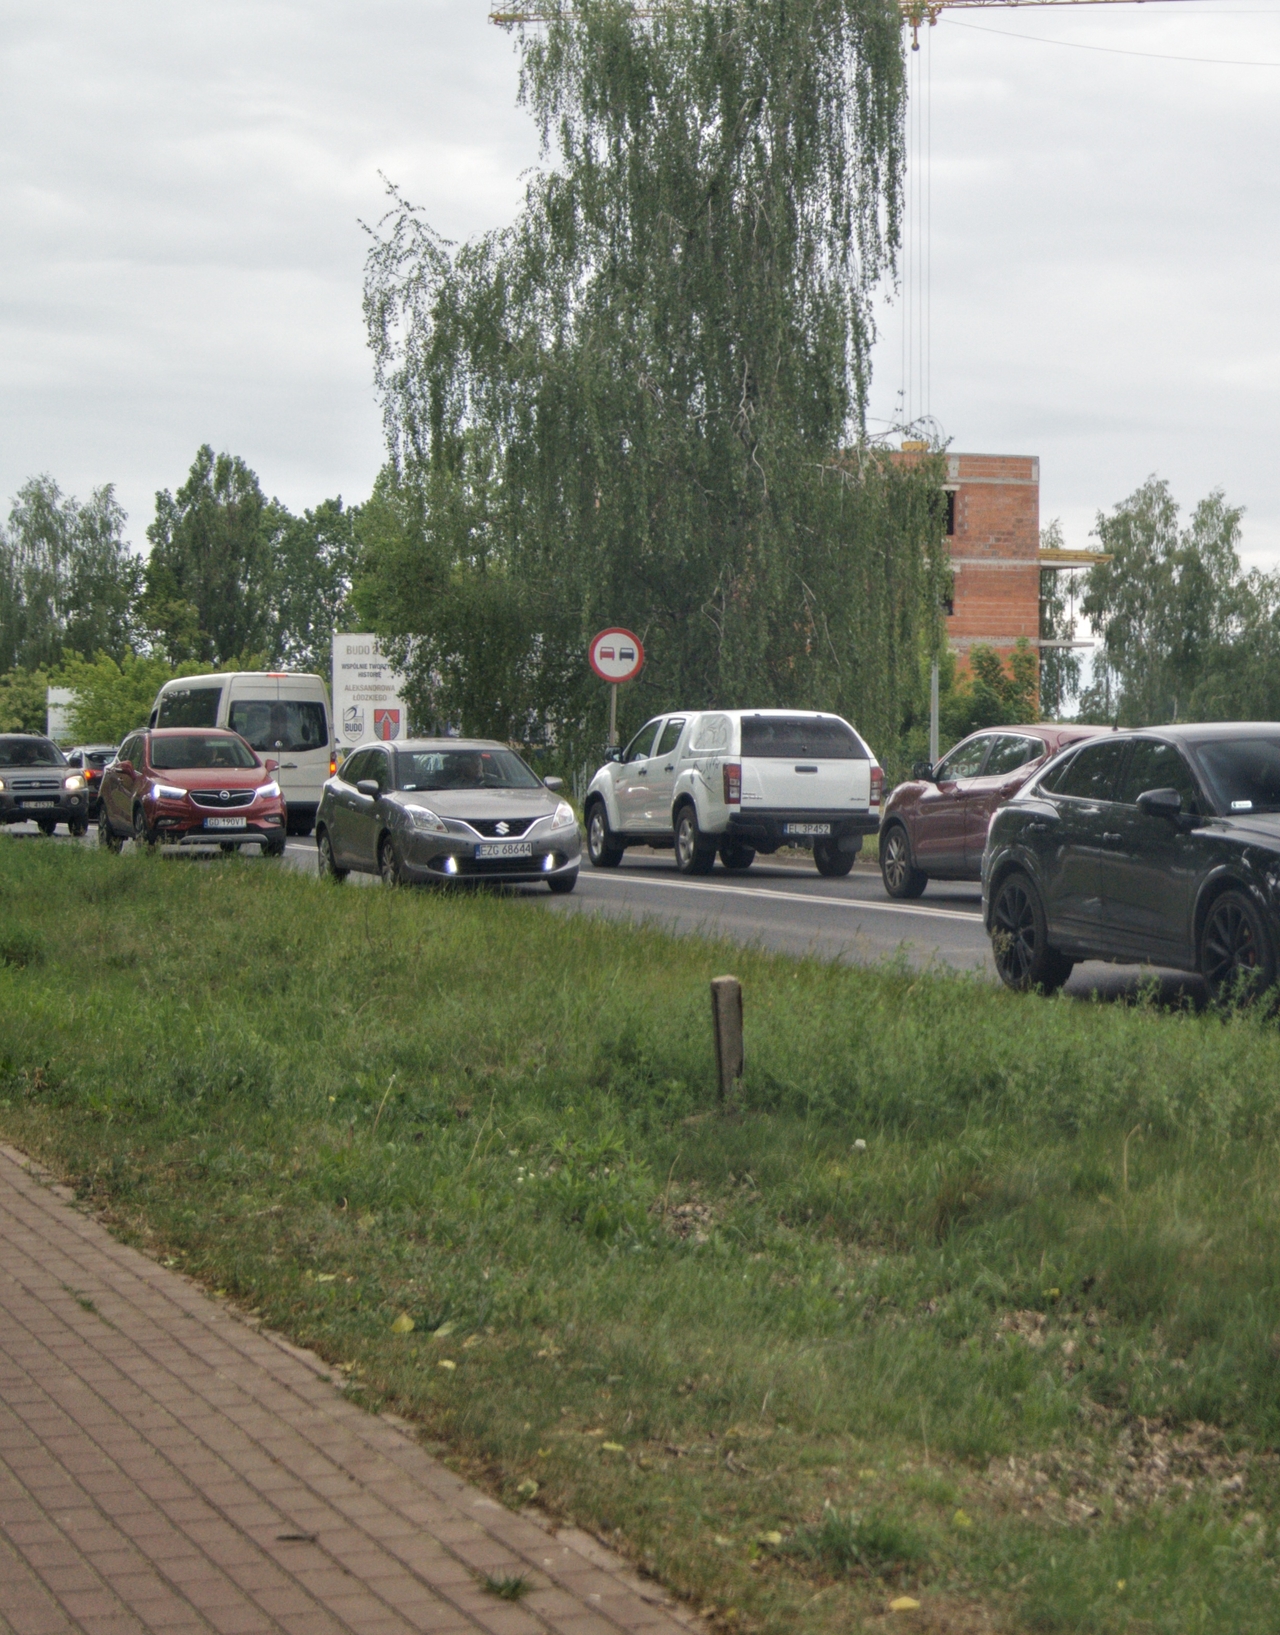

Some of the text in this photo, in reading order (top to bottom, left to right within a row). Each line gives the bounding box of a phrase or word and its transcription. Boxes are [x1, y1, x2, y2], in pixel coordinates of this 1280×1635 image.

[346, 645, 370, 655] BUDO
[344, 684, 395, 692] ALEKSANDROWA
[345, 723, 363, 732] BUDO
[209, 818, 220, 826] GD
[789, 824, 799, 834] EL
[480, 843, 531, 856] EZG 68644
